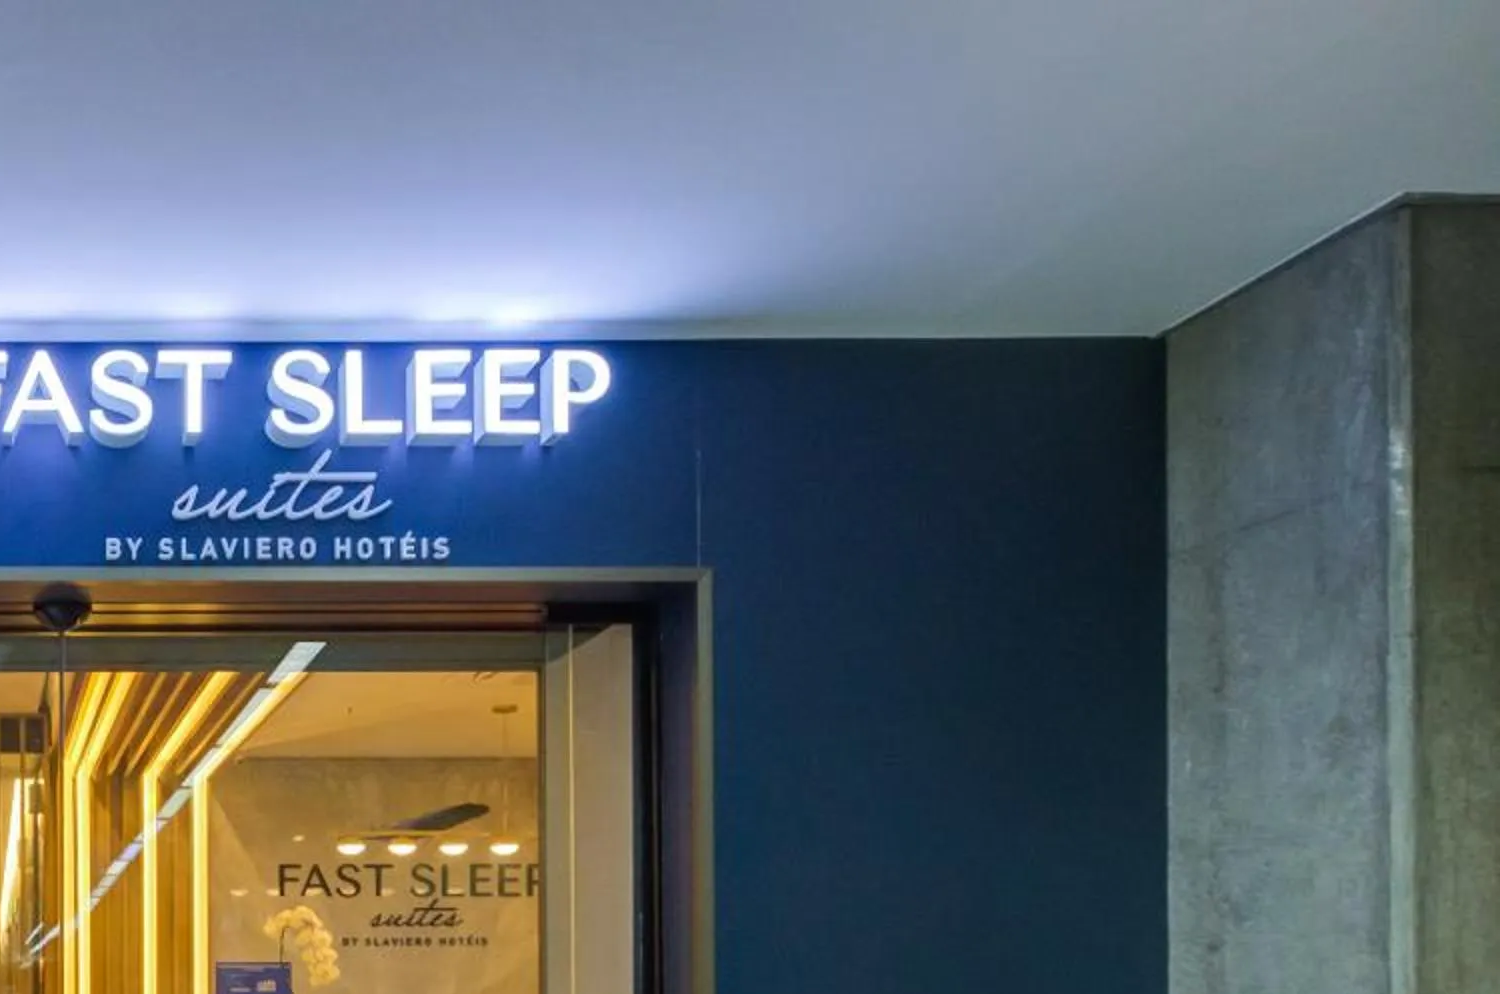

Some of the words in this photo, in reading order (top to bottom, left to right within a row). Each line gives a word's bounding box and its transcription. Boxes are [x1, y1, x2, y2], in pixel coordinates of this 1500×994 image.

[264, 348, 612, 448] SLEEP
[171, 448, 393, 521] suites
[105, 537, 143, 560] BY
[158, 537, 317, 560] SLAVIERO
[334, 530, 451, 560] HOTÉIS
[278, 863, 395, 897] FAST
[370, 898, 464, 927] suites
[342, 937, 358, 947] BY
[364, 937, 432, 947] SLAVIERO
